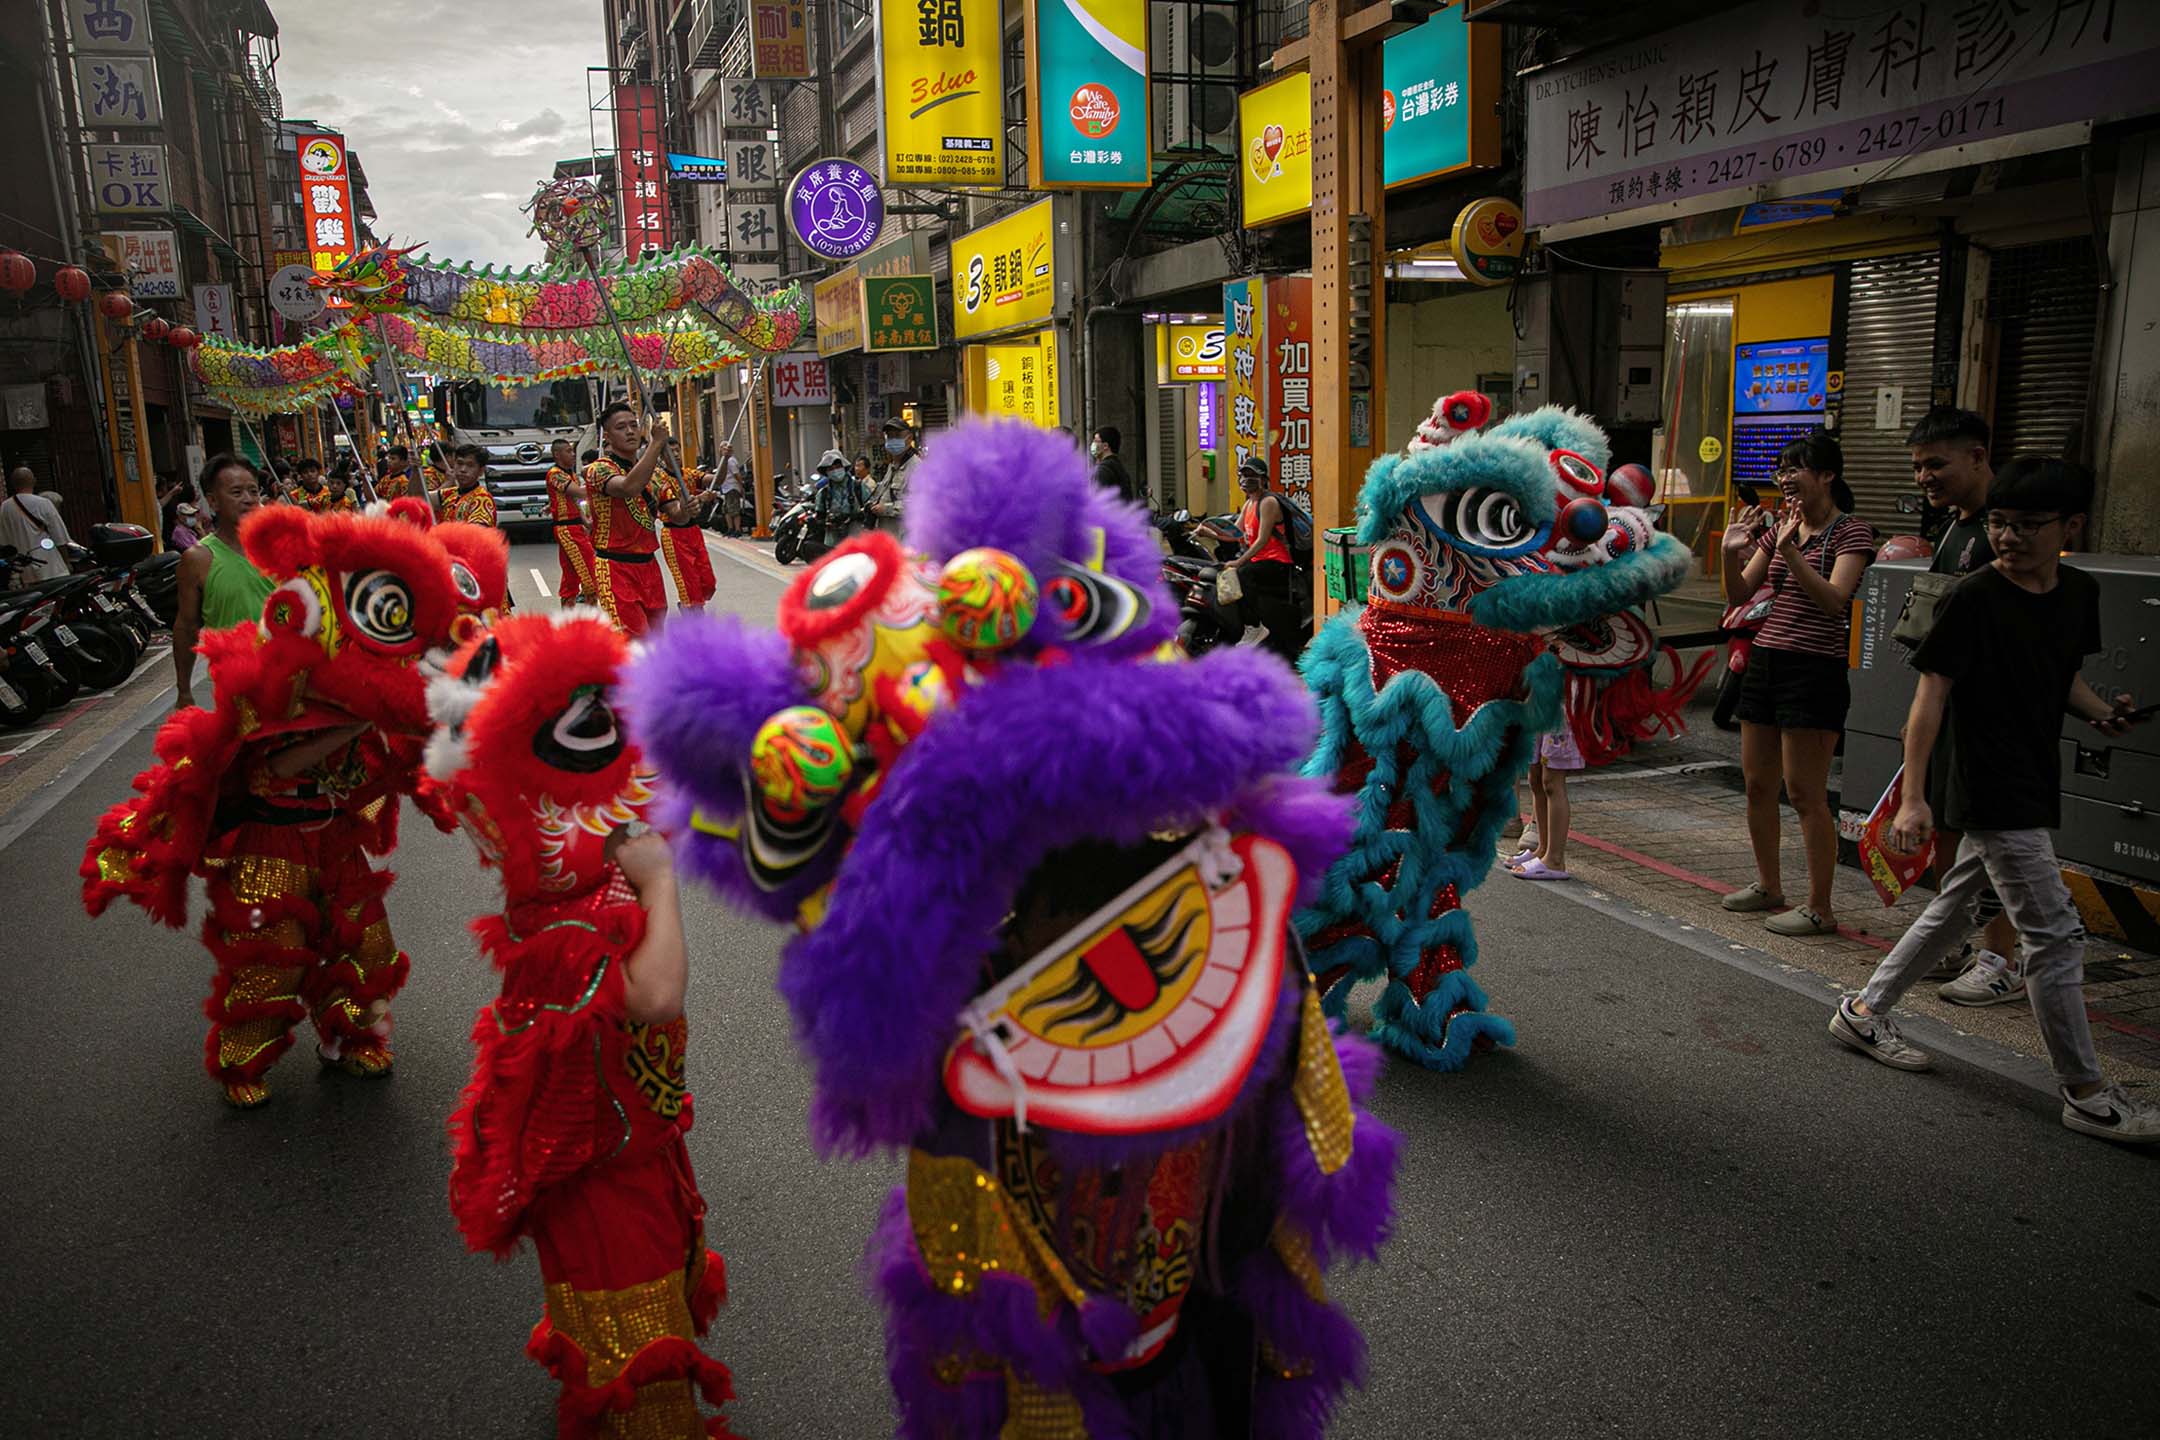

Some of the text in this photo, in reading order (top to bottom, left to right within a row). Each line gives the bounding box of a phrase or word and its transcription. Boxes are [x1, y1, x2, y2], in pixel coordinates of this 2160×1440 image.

[917, 0, 965, 47] 鍋
[84, 0, 147, 120] 西湖
[911, 69, 977, 103] 3duo
[1402, 82, 1458, 122] 台灣彩券
[1070, 150, 1122, 165] 台灣彩券
[1707, 137, 1826, 185] 2427-6789
[1857, 97, 2005, 156] 2427-0171
[97, 152, 158, 178] 卡拉
[670, 172, 727, 181] APOLLO
[731, 84, 776, 251] 孫眼科
[102, 183, 161, 208] OK
[311, 185, 347, 247] 歡樂
[776, 361, 828, 398] 快照
